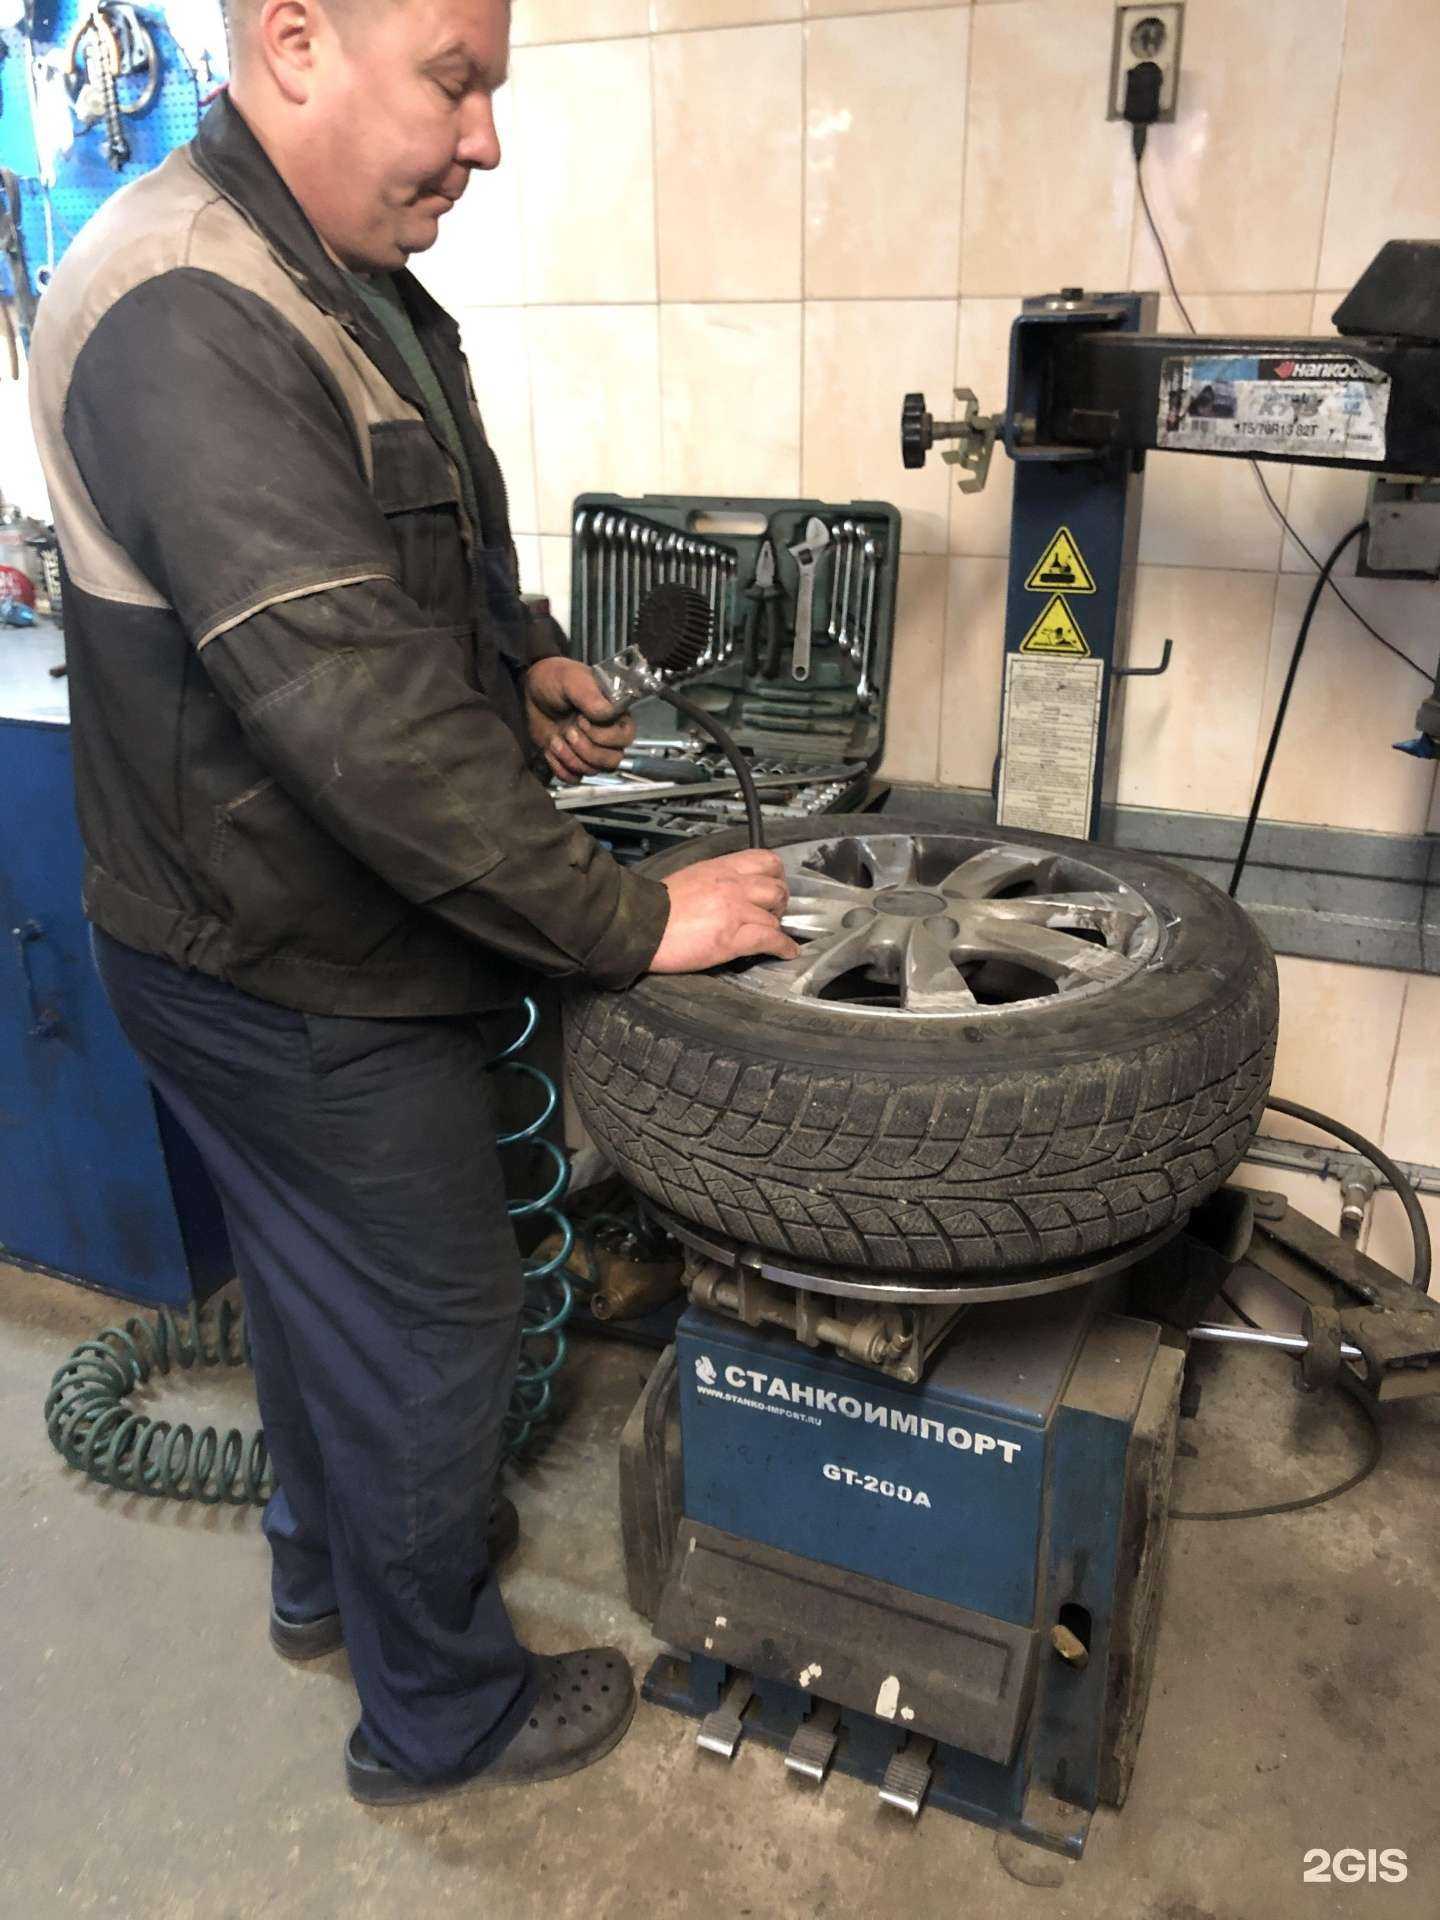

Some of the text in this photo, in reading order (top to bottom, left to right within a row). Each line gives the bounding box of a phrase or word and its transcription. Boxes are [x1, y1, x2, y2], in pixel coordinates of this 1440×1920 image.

[1291, 362, 1366, 378] Hankoo
[724, 1365, 1022, 1464] СТАНКОИМПОРТ
[822, 1463, 932, 1509] GT-200A
